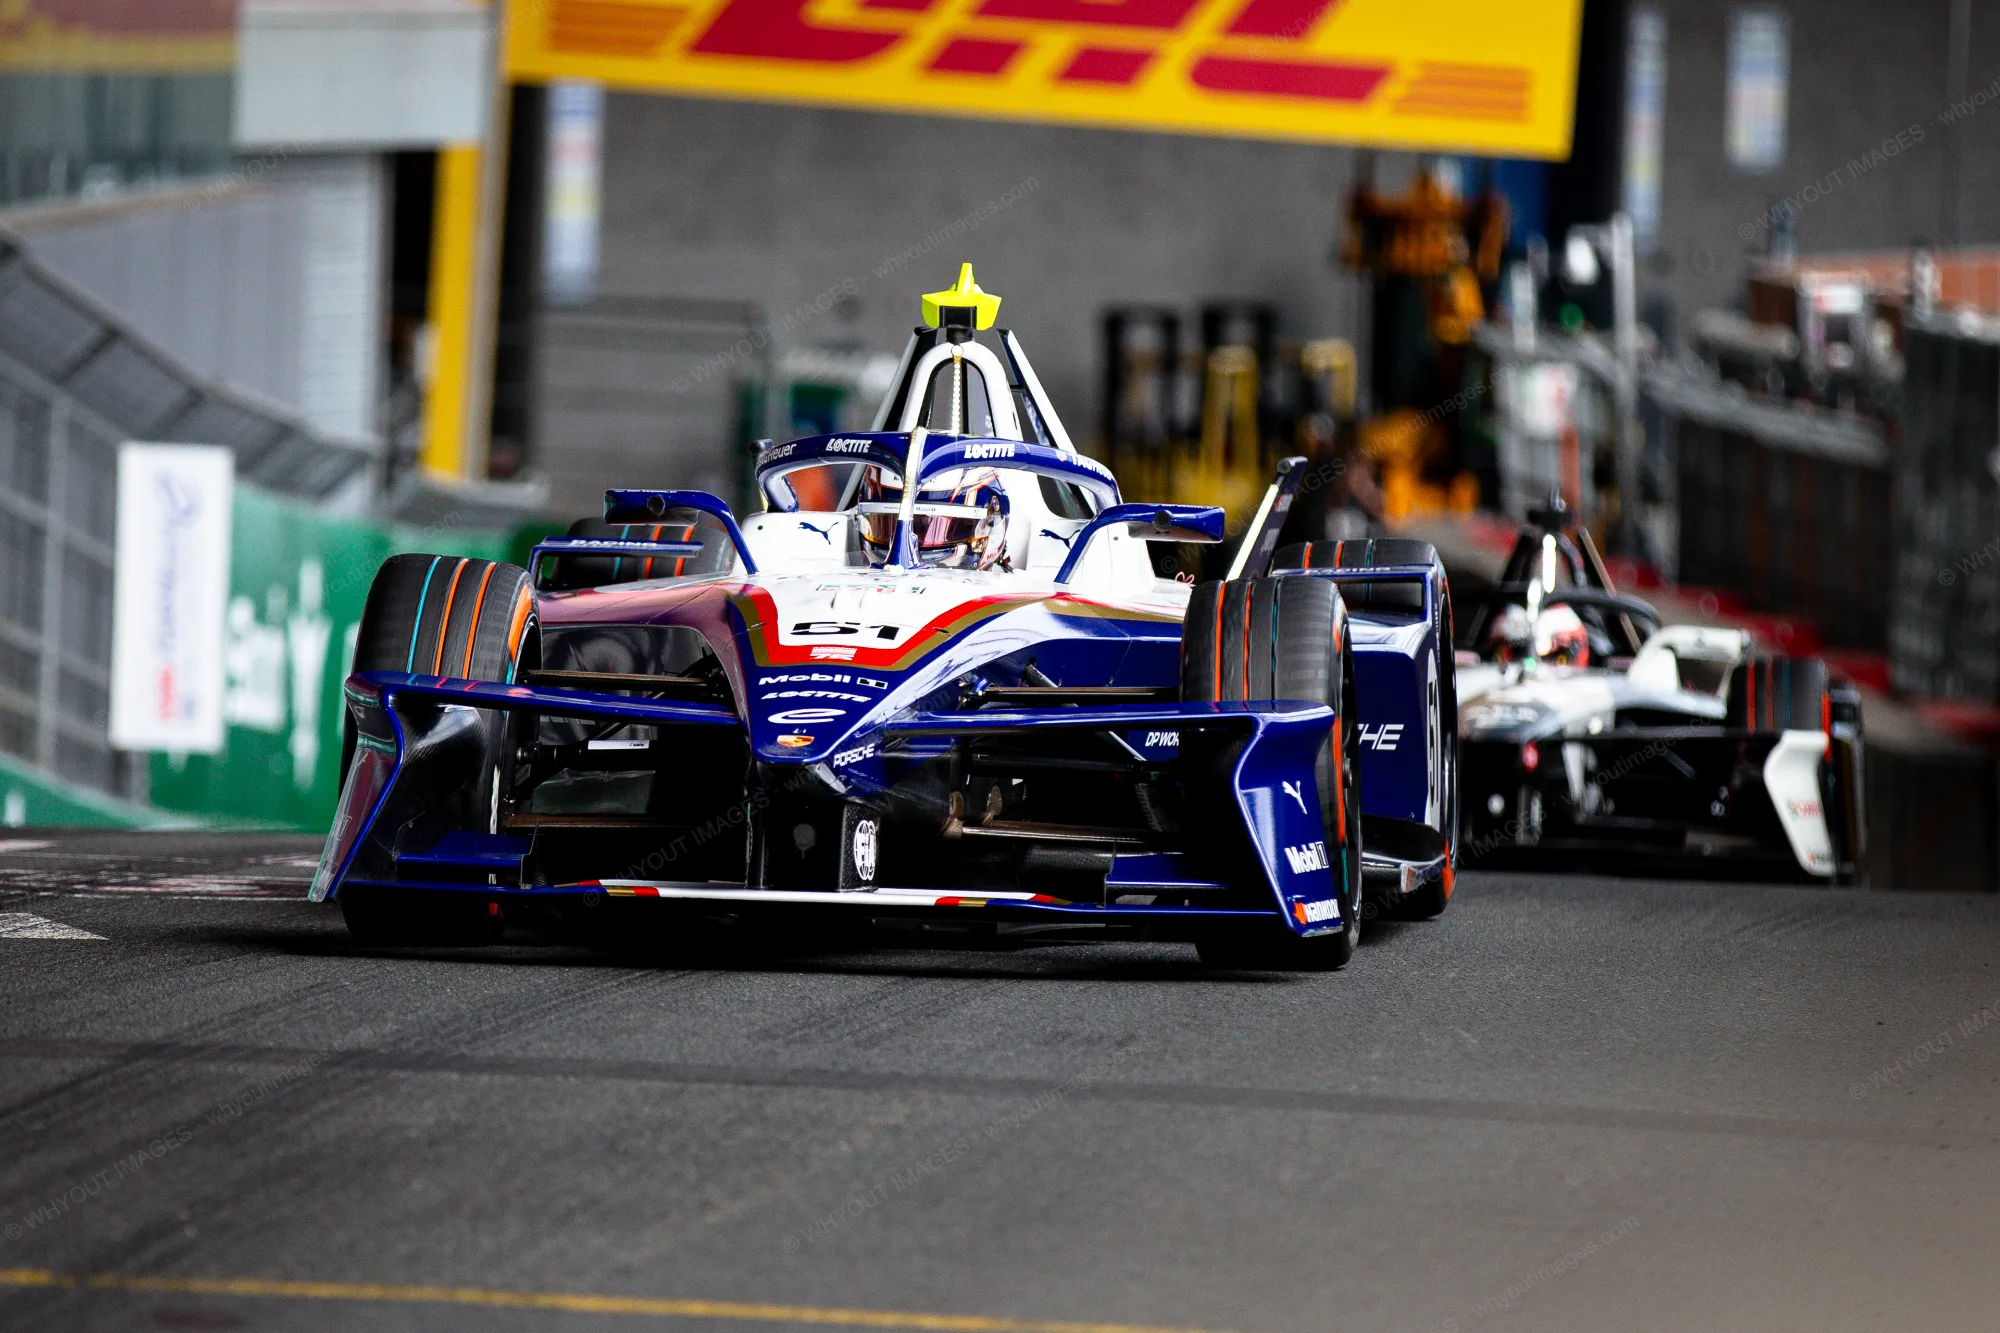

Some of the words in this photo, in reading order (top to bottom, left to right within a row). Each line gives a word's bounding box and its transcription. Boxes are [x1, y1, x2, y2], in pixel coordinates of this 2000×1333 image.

[826, 438, 872, 453] LOCTITE
[964, 444, 1015, 459] LOCTITE
[790, 621, 899, 640] 51
[758, 673, 851, 685] Mobil
[761, 690, 872, 703] LOCTITE
[1145, 731, 1160, 747] DP
[833, 743, 875, 768] PORSCHE
[1284, 842, 1322, 874] Mobil
